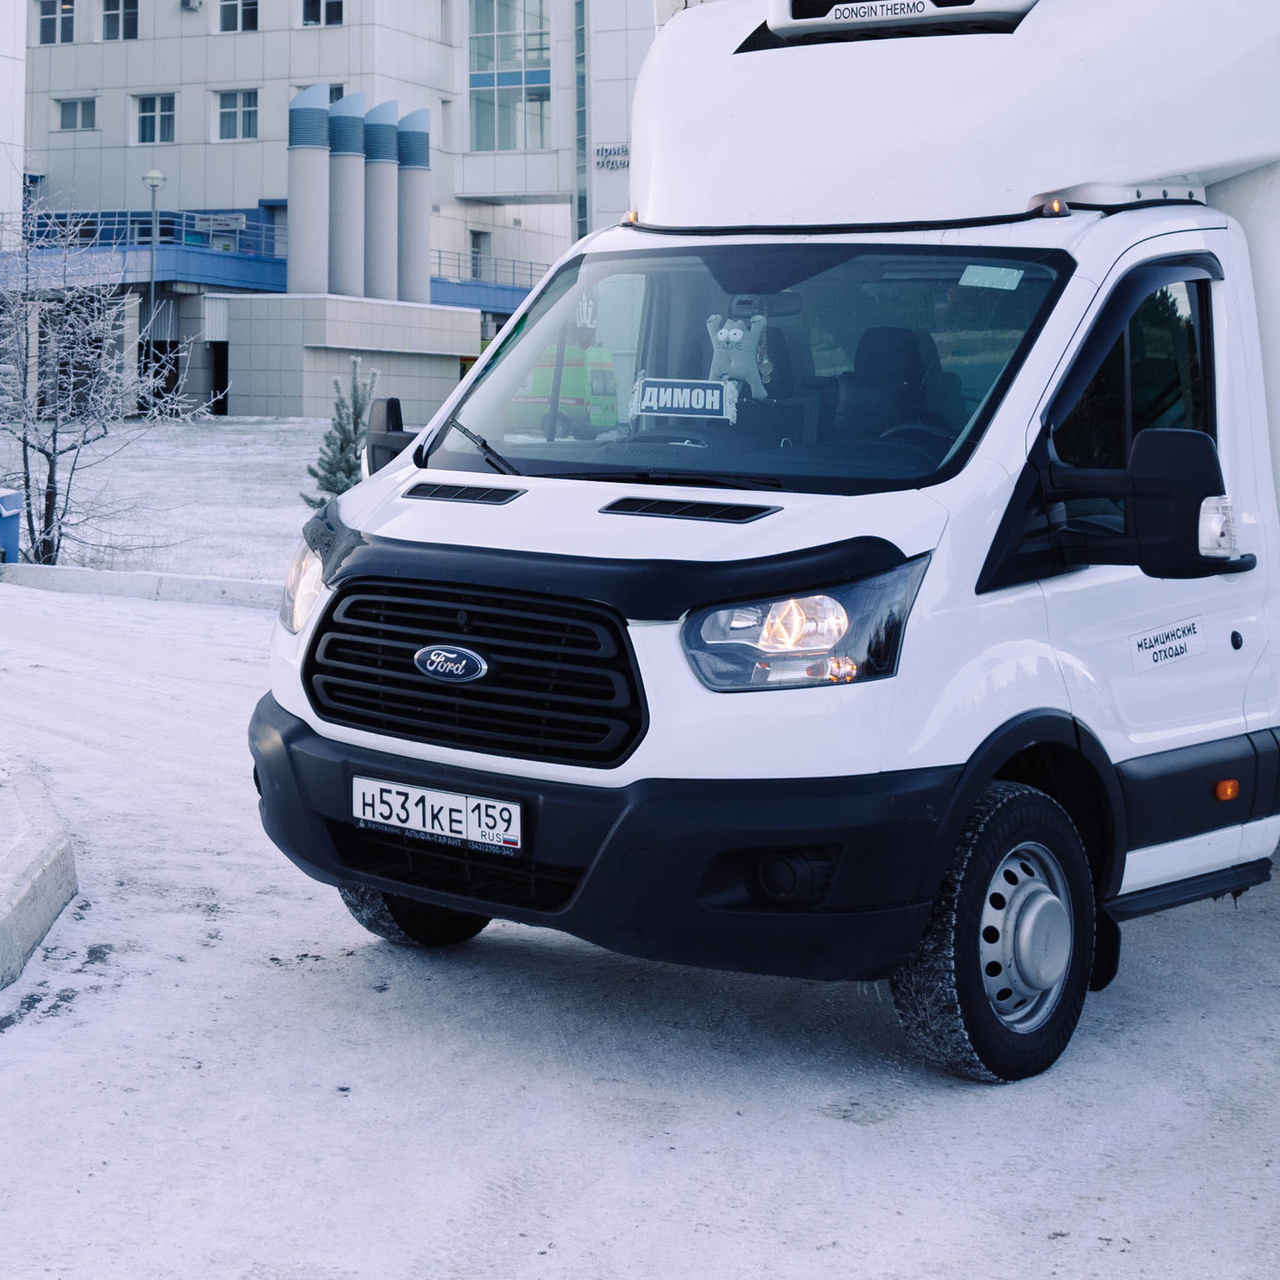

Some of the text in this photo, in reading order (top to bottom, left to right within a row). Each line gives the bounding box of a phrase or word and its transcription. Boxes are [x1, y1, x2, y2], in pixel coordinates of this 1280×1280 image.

[834, 0, 925, 20] DONGIN THERMO
[641, 387, 720, 411] ДИМОН
[1136, 623, 1197, 652] МЕДИЦИНСКИЕ
[426, 650, 467, 675] Ford
[1152, 642, 1188, 663] ОТХОДЫ
[471, 802, 513, 833] 159
[404, 829, 462, 847] АЛЬФА-ГАРАНТ
[481, 830, 502, 843] RUS
